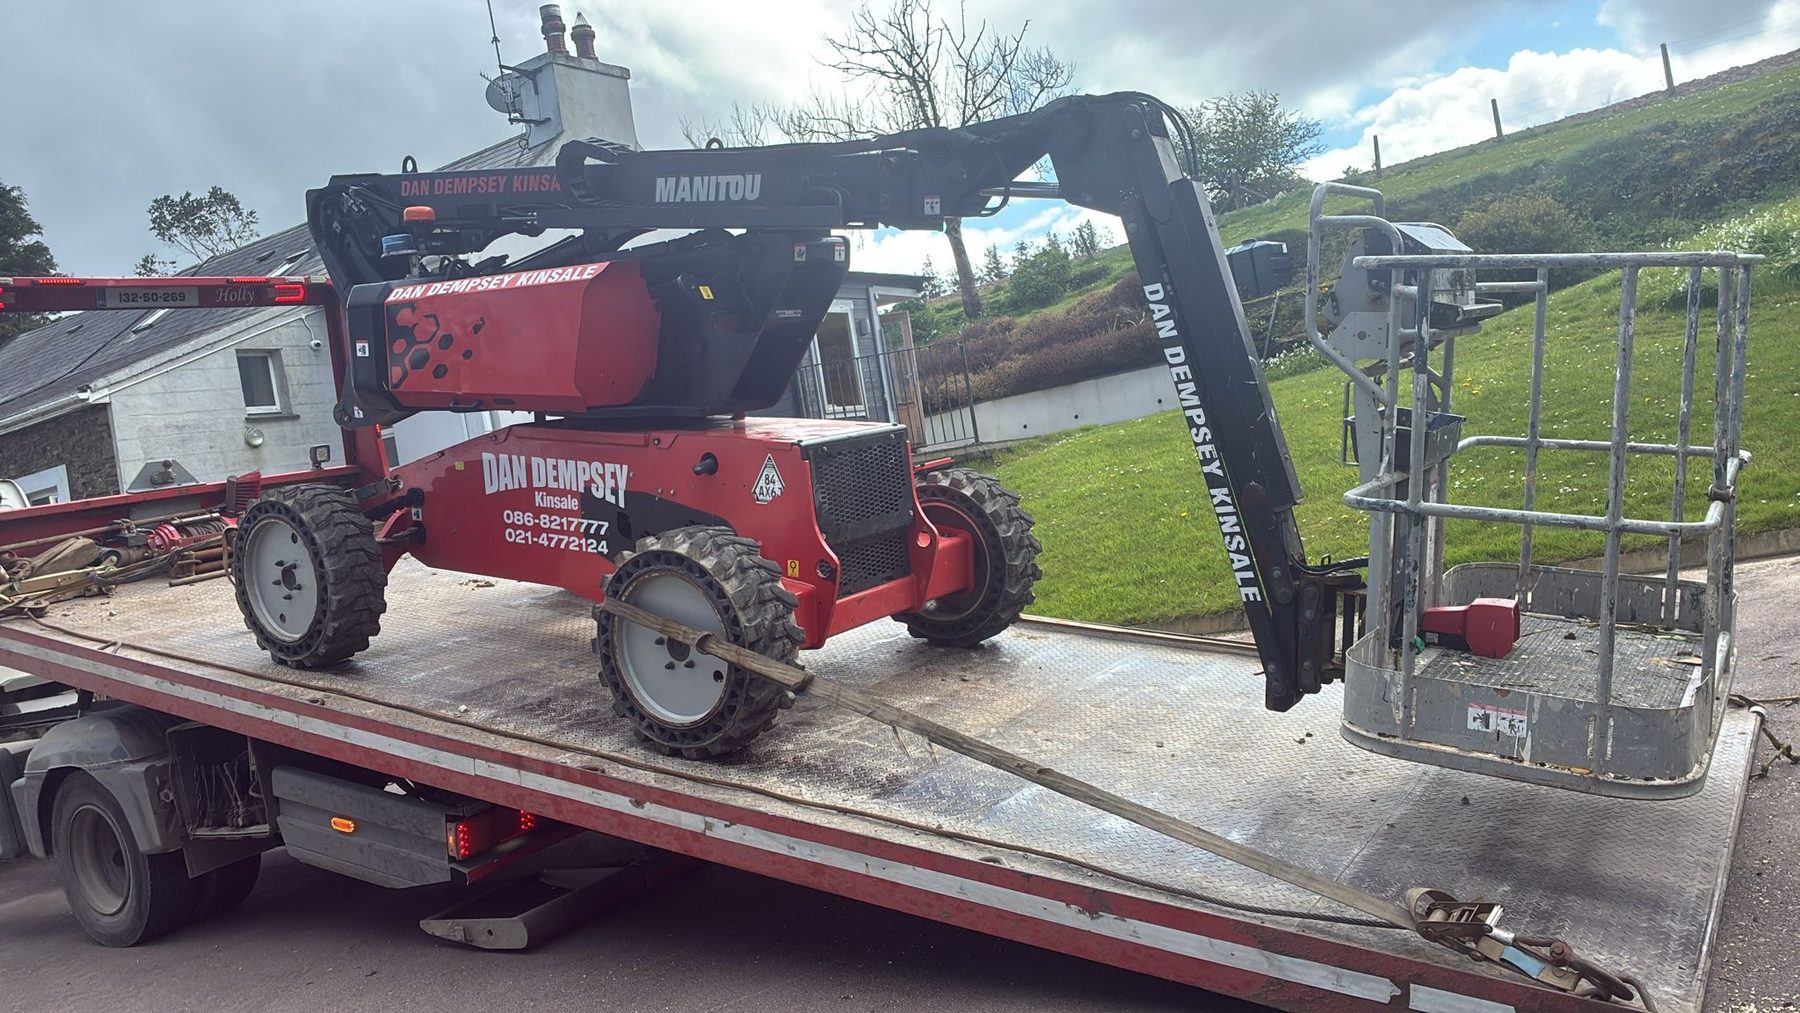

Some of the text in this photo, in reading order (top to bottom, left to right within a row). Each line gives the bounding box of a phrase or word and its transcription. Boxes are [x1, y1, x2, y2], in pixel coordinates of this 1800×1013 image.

[401, 174, 561, 197] DAN DEMPSEY KINSA
[655, 174, 762, 202] MANITOU
[216, 286, 255, 305] Holly
[388, 265, 599, 301] DAN DEMPSEY KINSALE
[1143, 282, 1262, 603] DAN DEMPSEY KINSALE
[481, 452, 628, 509] DAN DEMPSEY
[764, 473, 776, 485] 84
[534, 491, 579, 510] Kinsale
[503, 510, 609, 536] 086-8217777
[505, 528, 609, 555] 021-4772124
